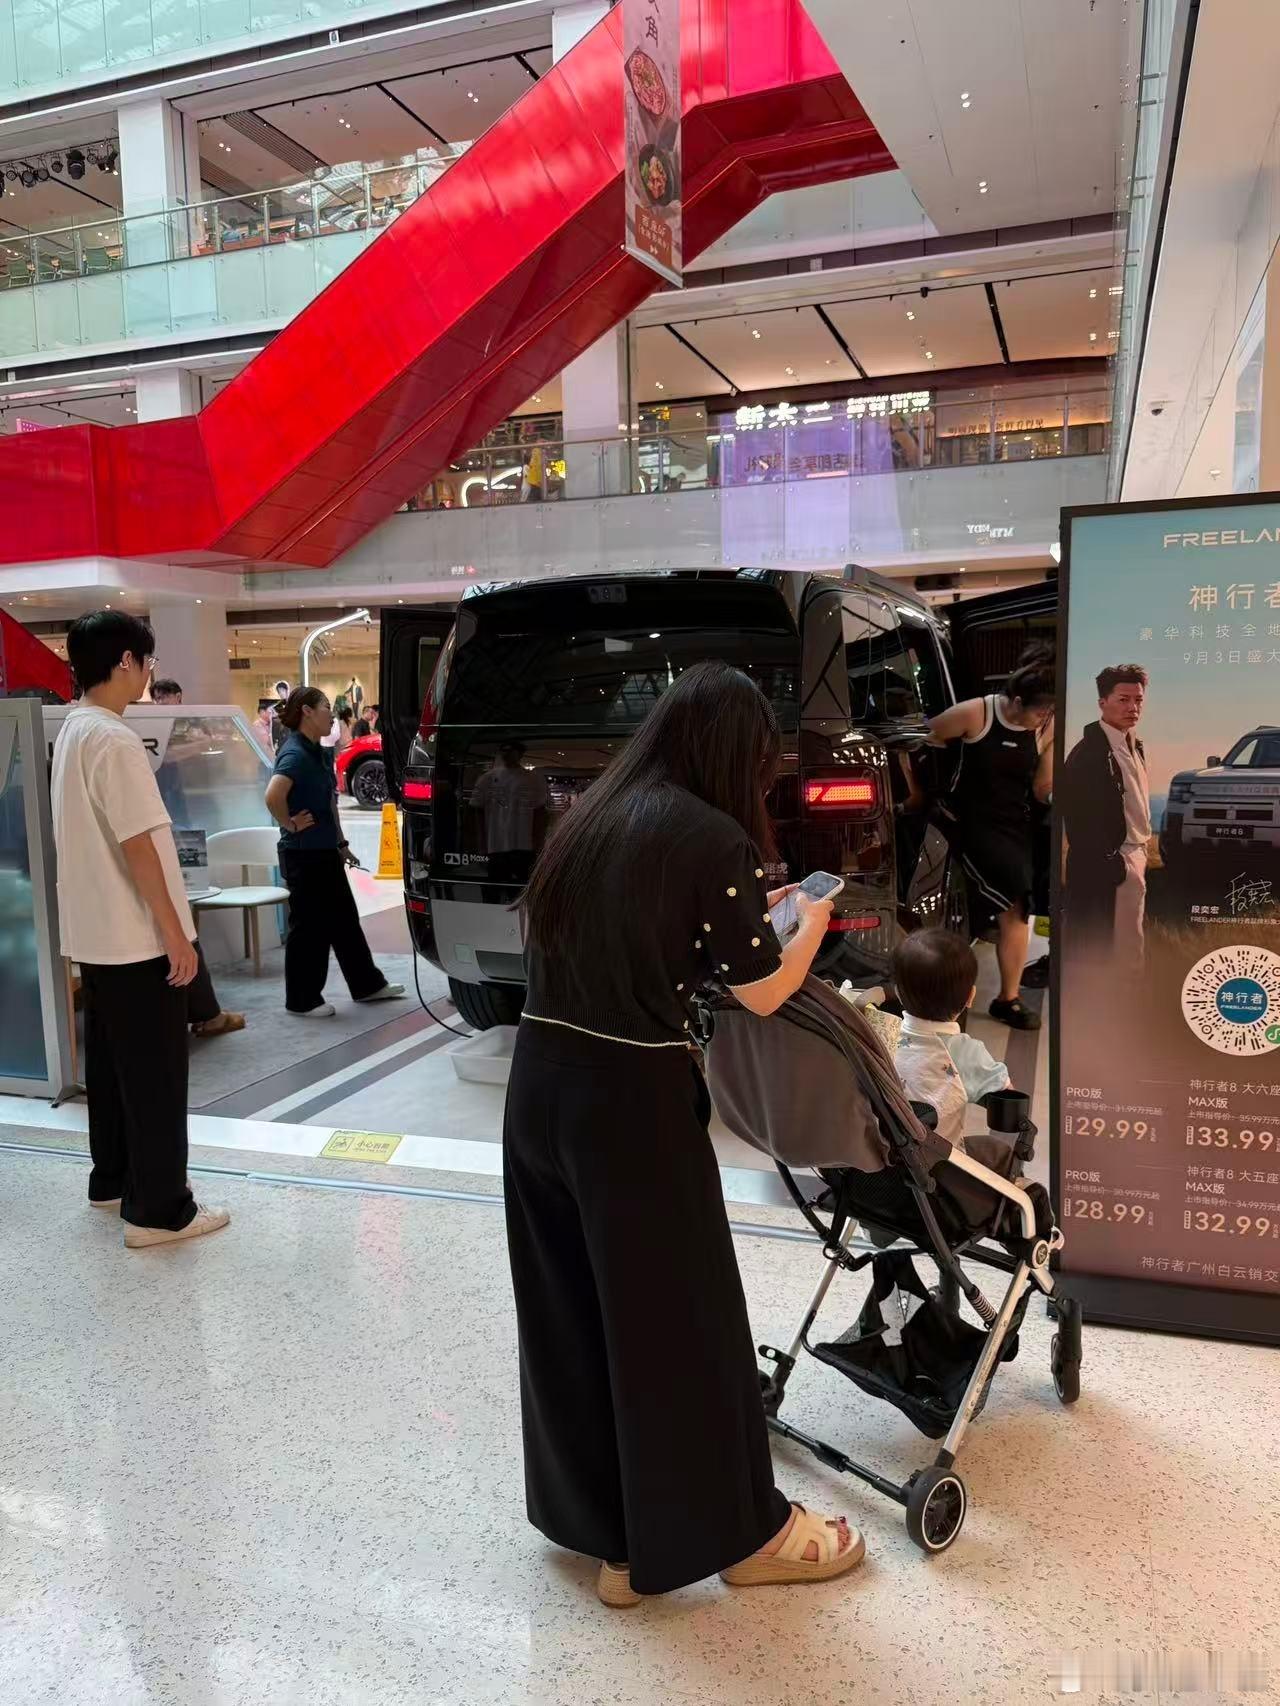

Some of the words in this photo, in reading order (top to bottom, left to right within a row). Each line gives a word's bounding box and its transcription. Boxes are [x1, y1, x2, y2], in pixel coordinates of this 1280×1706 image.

[1220, 991, 1263, 1005] 神行者
[1066, 1086, 1103, 1099] PRO版
[1190, 1079, 1237, 1093] 神行者8
[1242, 1083, 1280, 1096] 大六座
[1188, 1096, 1229, 1109] MAX版
[1076, 1117, 1148, 1140] 29.99
[1197, 1126, 1274, 1151] 33.99
[1065, 1170, 1101, 1182] PRO版
[1187, 1166, 1234, 1179] 神行者8
[1239, 1170, 1280, 1184] 大五座
[1185, 1181, 1225, 1194] MAX版
[1075, 1199, 1145, 1224] 28.99
[1194, 1211, 1270, 1237] 32.99
